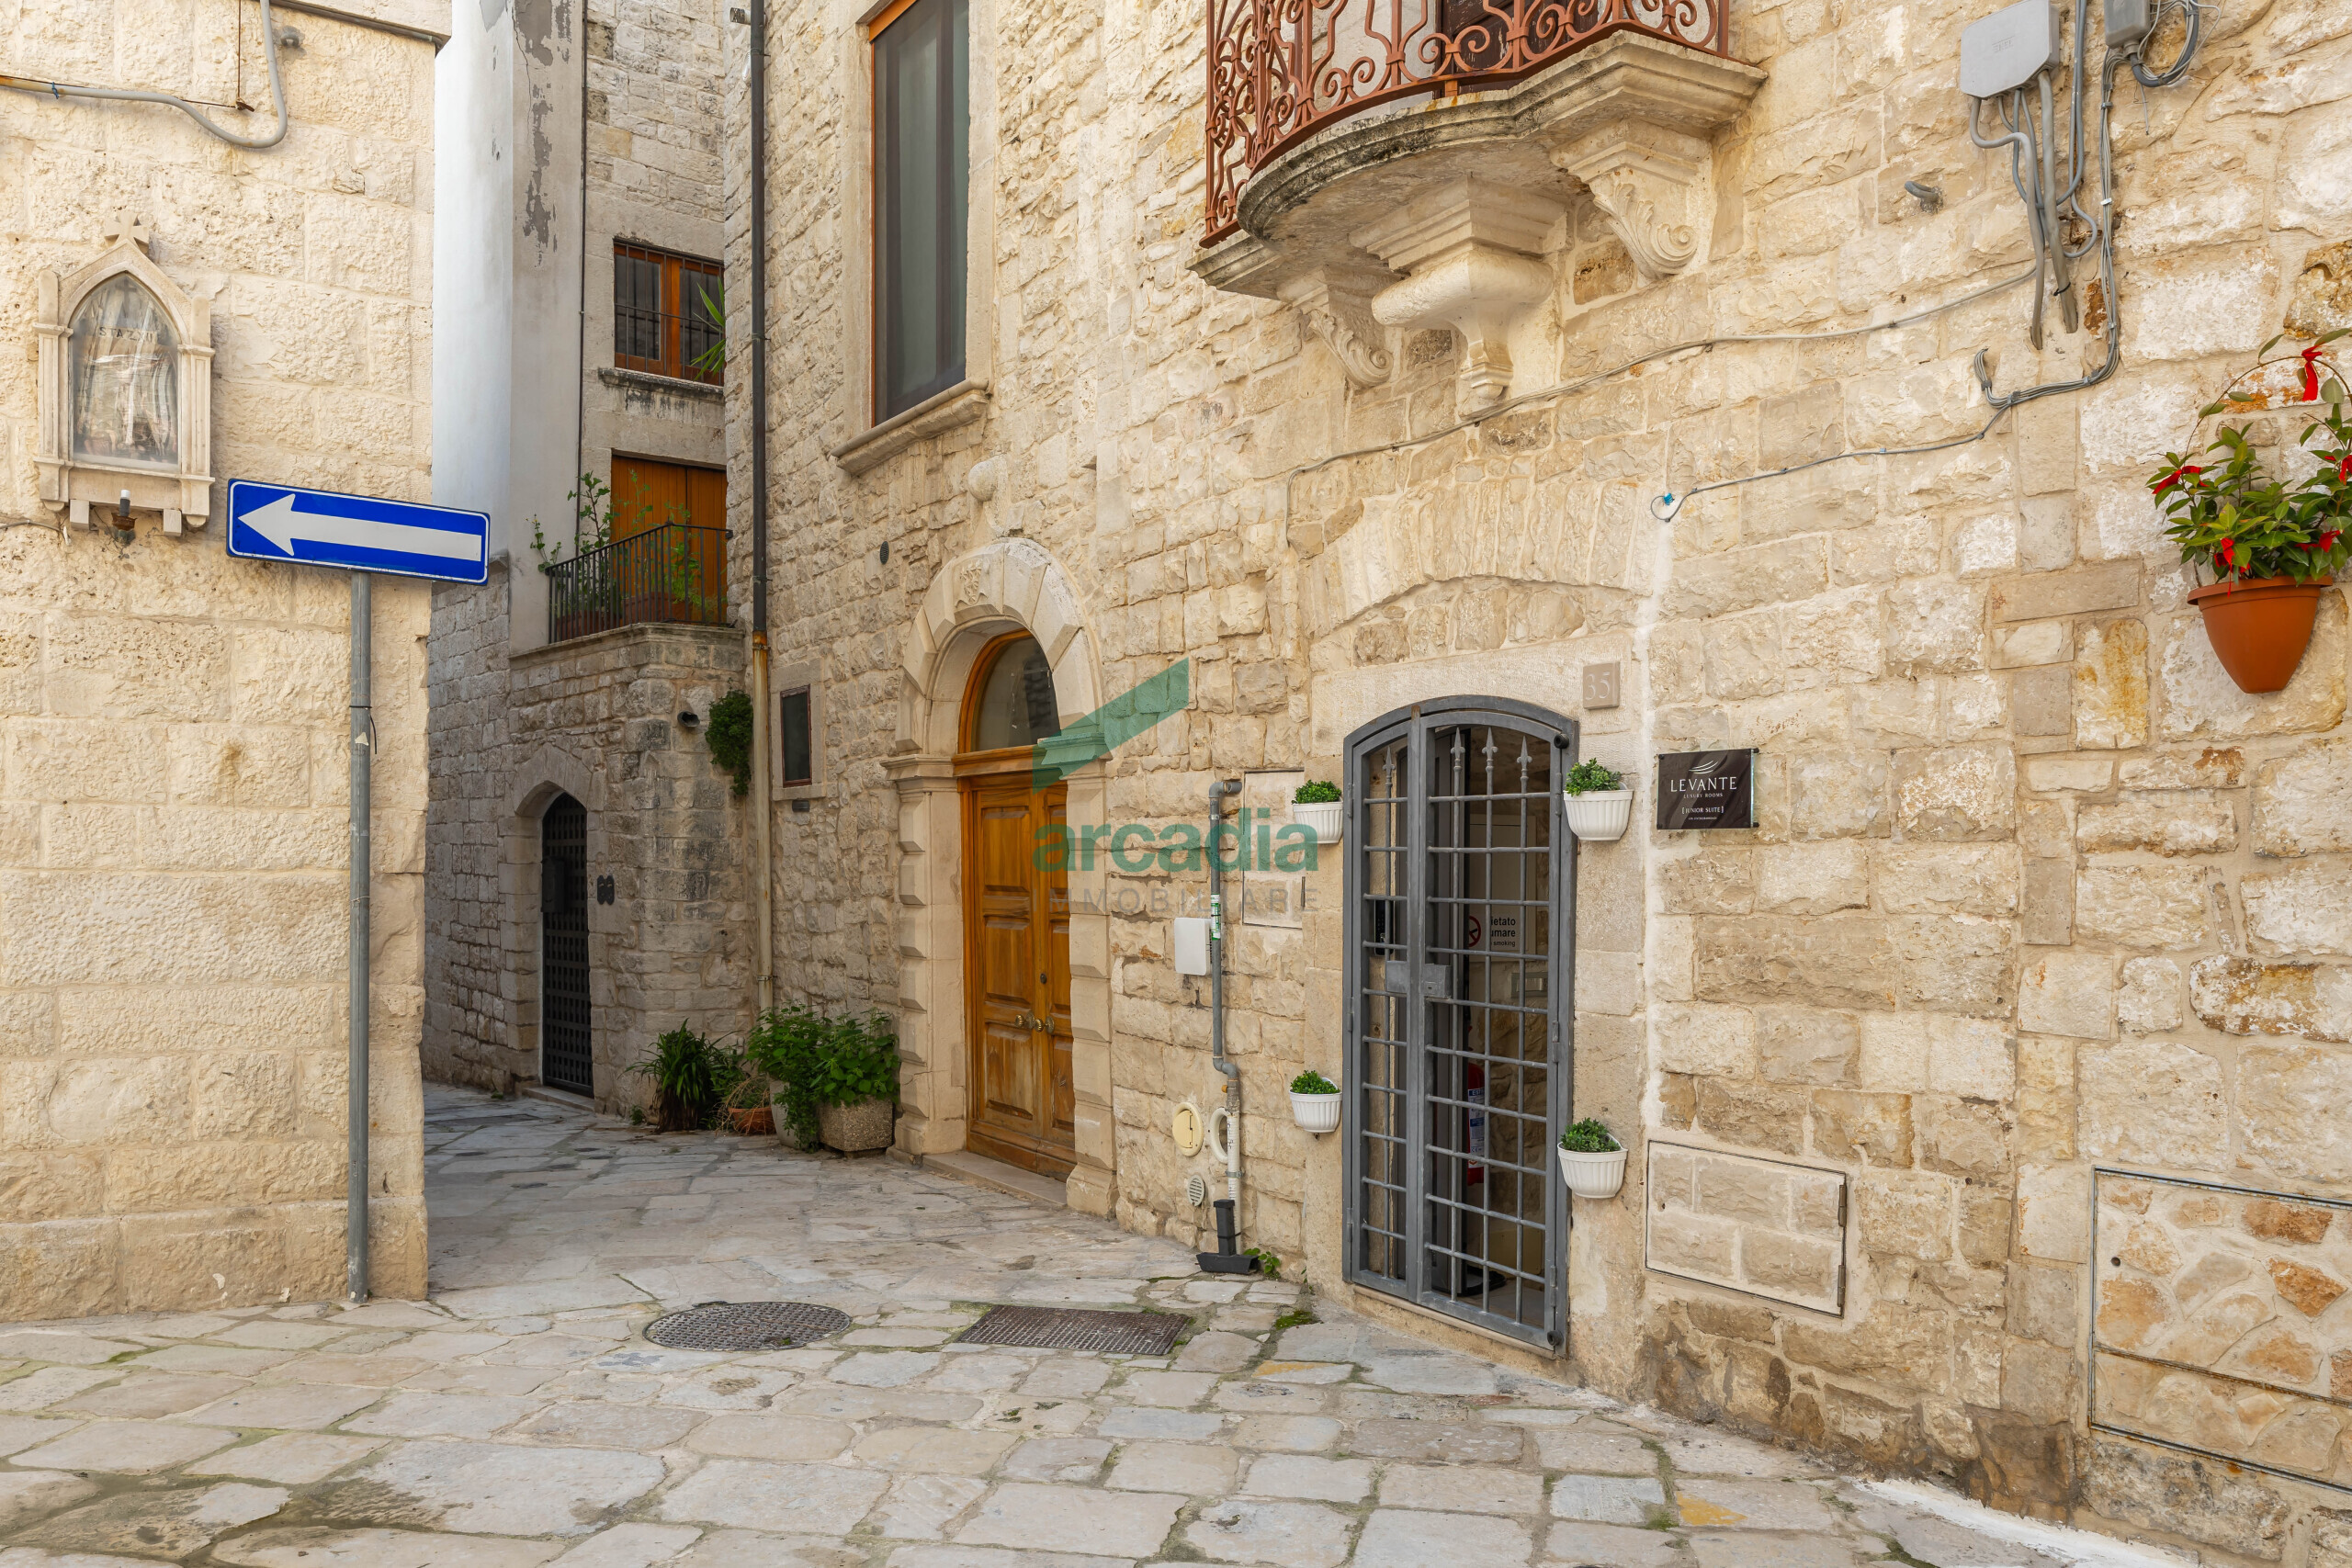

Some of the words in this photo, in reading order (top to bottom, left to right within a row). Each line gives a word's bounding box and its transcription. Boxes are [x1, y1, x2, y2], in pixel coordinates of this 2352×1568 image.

[1585, 671, 1611, 701] 35
[1670, 776, 1737, 792] LEVANTE
[1490, 916, 1516, 926] ietato
